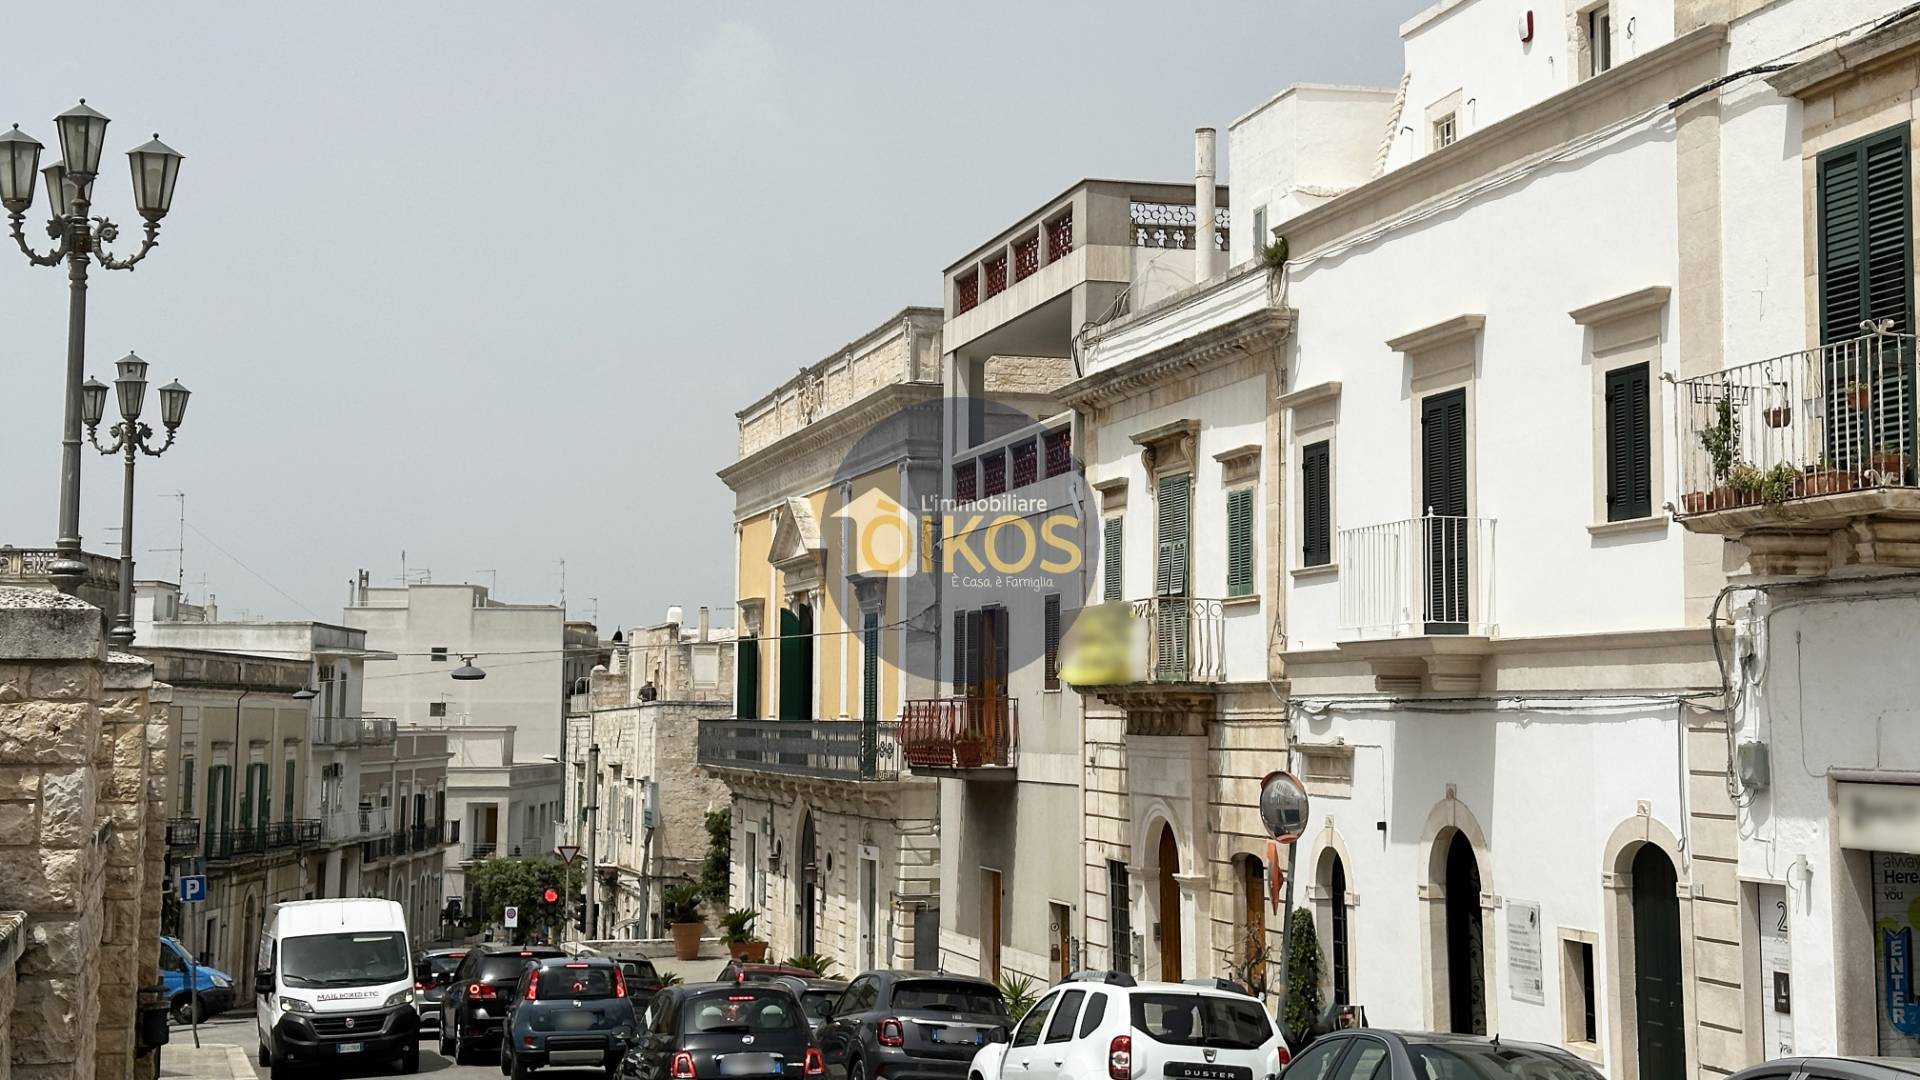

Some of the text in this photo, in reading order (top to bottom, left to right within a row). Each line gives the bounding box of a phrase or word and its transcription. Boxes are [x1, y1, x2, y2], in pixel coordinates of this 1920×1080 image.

[186, 879, 200, 900] P
[1890, 940, 1906, 1025] ENTER
[1184, 1069, 1236, 1079] DUSTER
